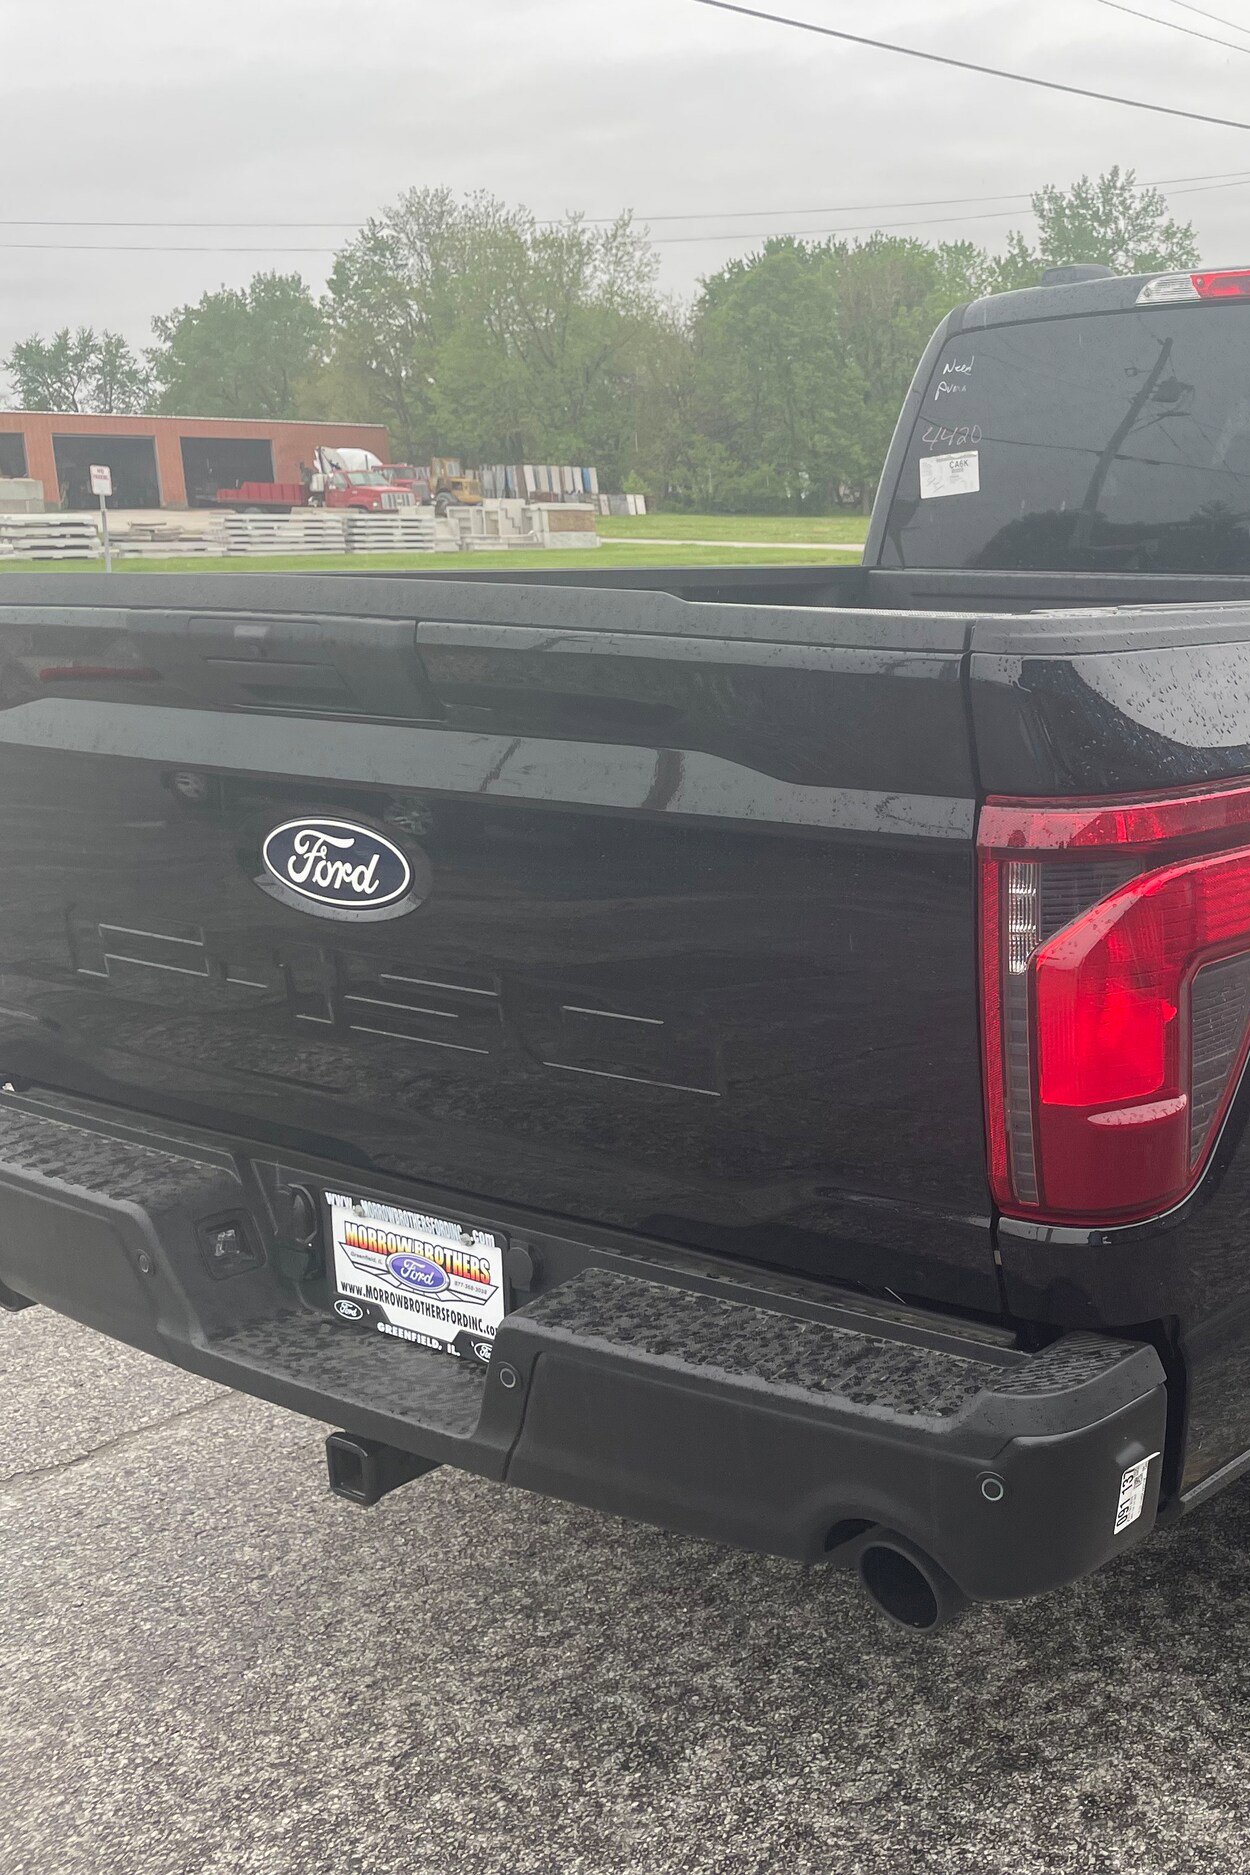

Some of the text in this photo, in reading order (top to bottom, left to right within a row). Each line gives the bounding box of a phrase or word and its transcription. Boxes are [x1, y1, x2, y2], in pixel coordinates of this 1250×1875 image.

[943, 355, 975, 376] Need
[922, 424, 983, 451] 4420
[287, 829, 380, 895] Ford
[400, 1258, 434, 1286] Ford
